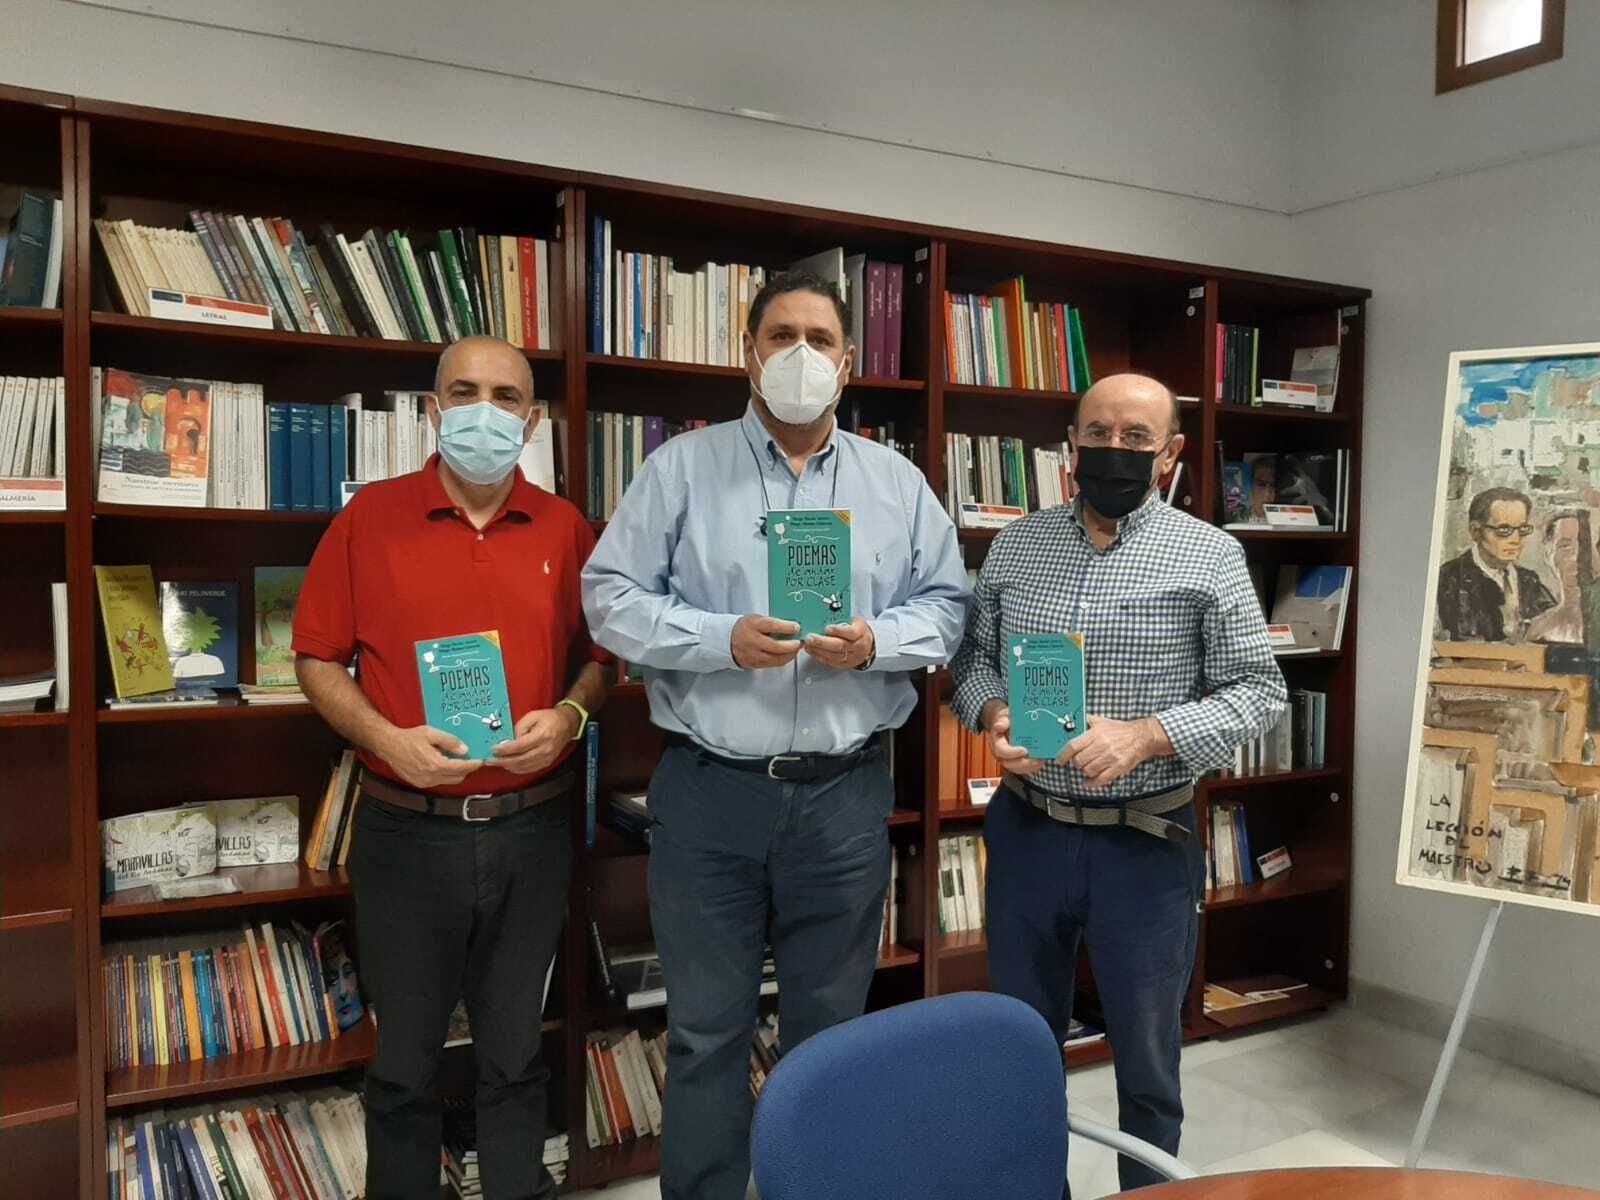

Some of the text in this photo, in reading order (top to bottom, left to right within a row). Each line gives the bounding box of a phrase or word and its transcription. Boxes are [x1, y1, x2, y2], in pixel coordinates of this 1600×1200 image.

[787, 544, 837, 567] POEMAS
[785, 576, 837, 587] POR CLASE
[439, 665, 491, 692] POEMAS
[1024, 666, 1070, 687] POEMAS
[1429, 793, 1451, 807] LA
[1426, 819, 1503, 839] LECCIÓN
[116, 850, 173, 873] MARAVILLAS
[1418, 848, 1493, 875] MAESTRO
